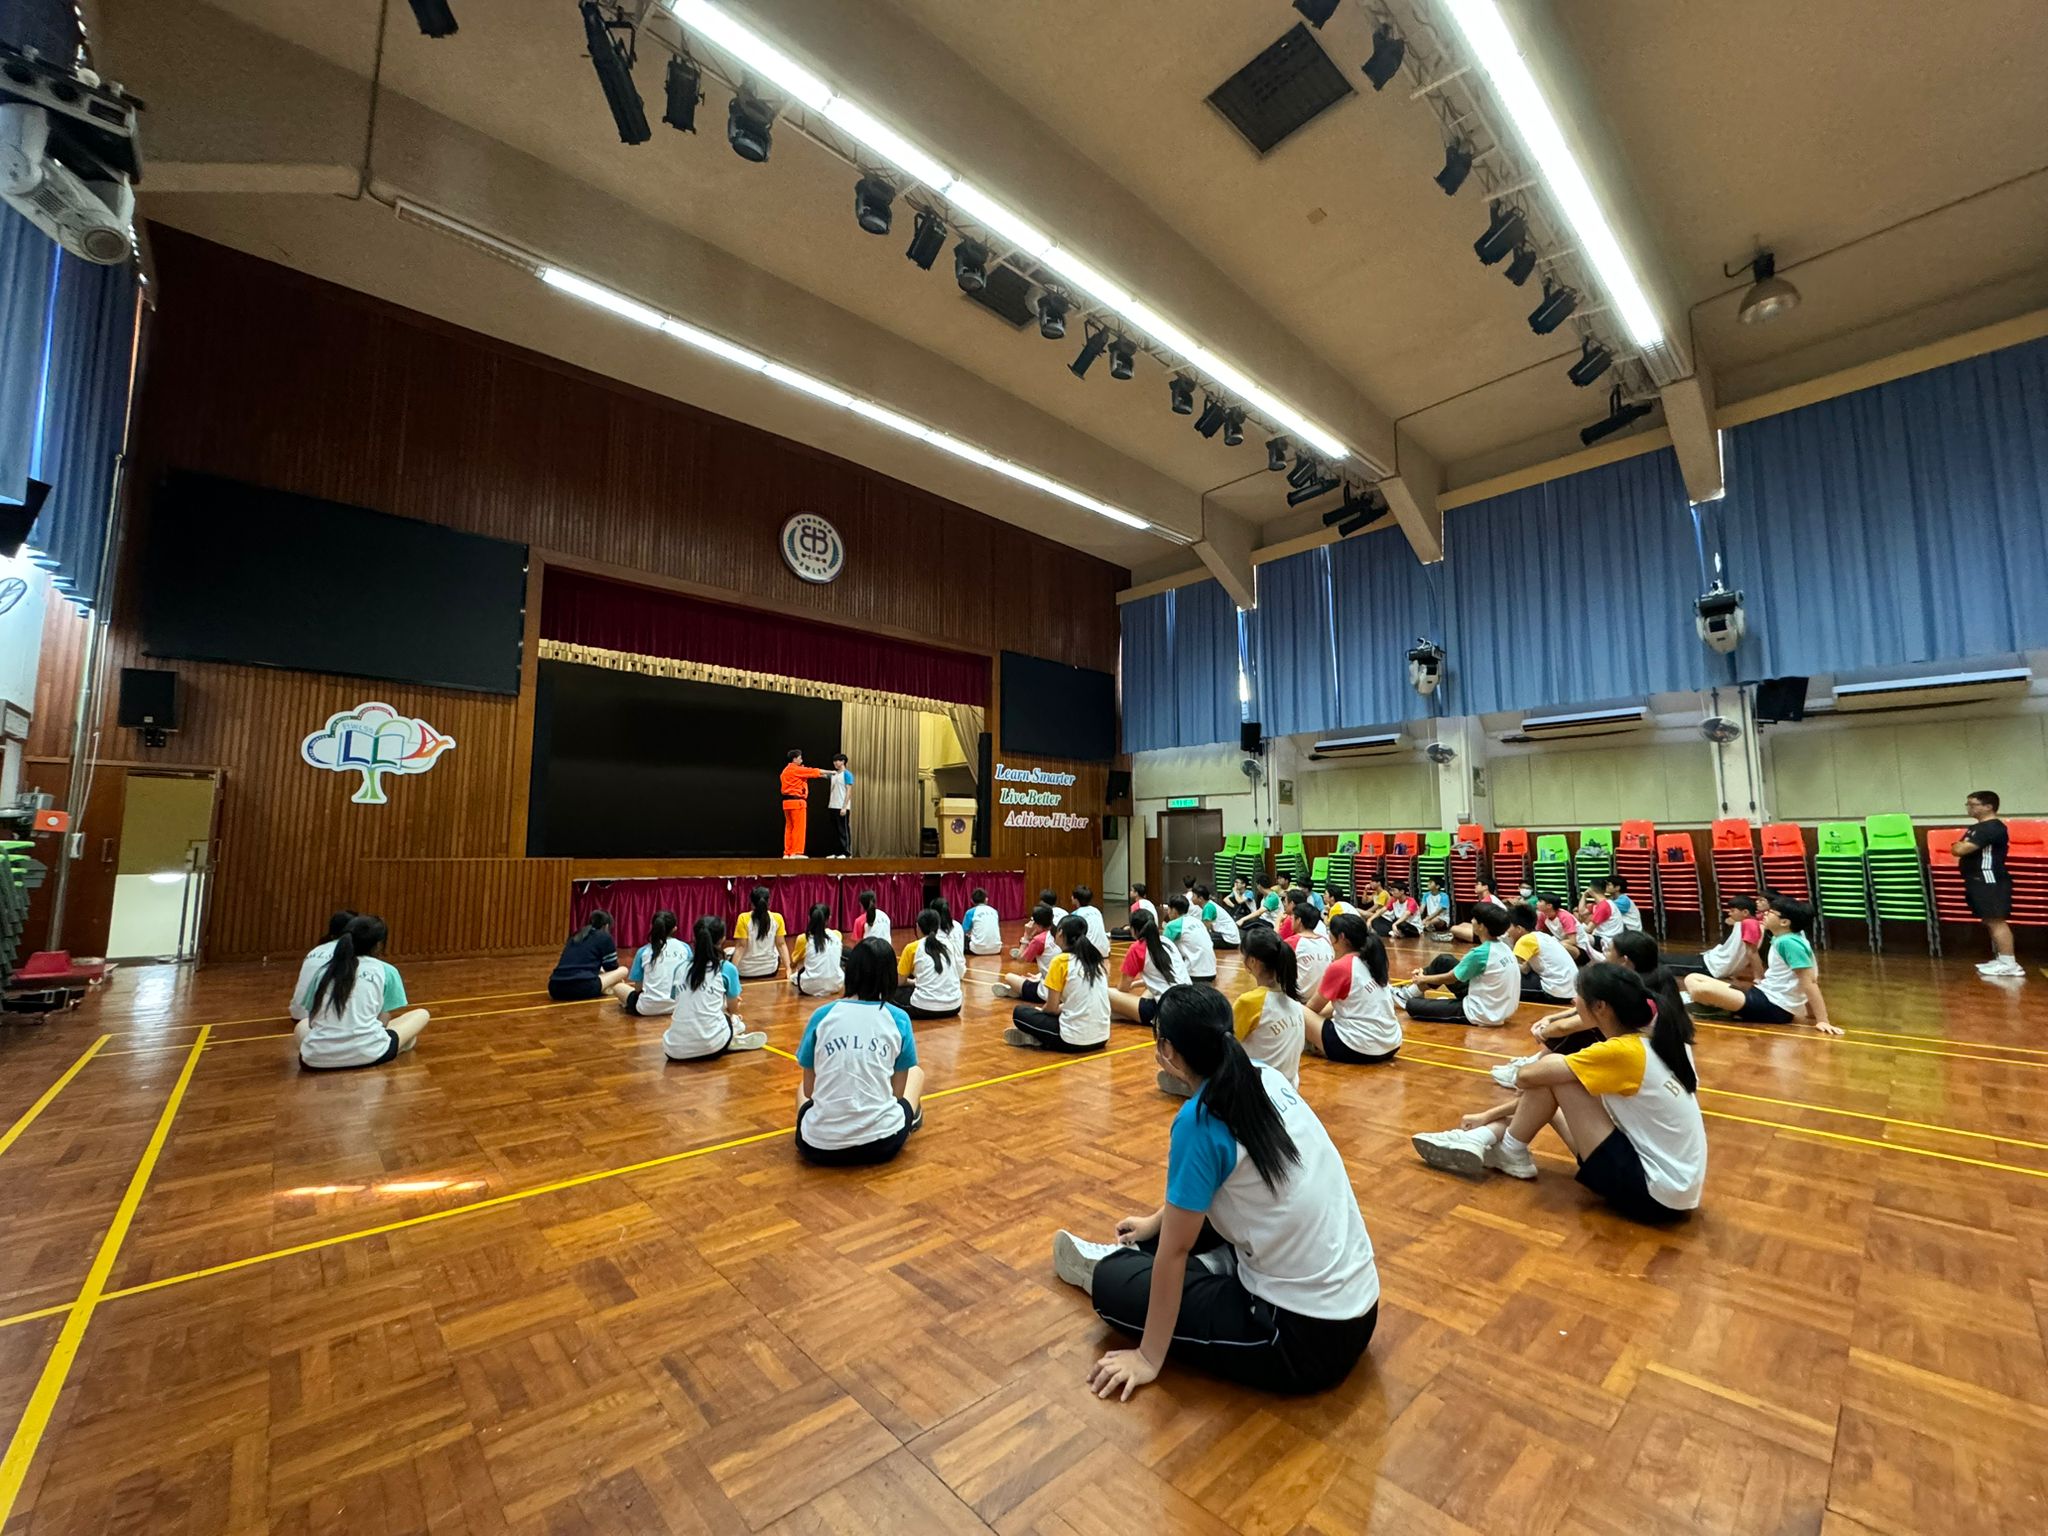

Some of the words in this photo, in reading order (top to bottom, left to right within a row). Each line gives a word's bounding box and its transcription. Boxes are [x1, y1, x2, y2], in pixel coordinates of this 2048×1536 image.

[995, 764, 1030, 782] Learn
[1032, 767, 1076, 786] Smarter
[999, 788, 1028, 804] Live
[1028, 789, 1061, 806] Better
[1004, 810, 1052, 828] Achieve
[1052, 812, 1089, 831] Higher
[824, 1035, 890, 1058] BWLSS
